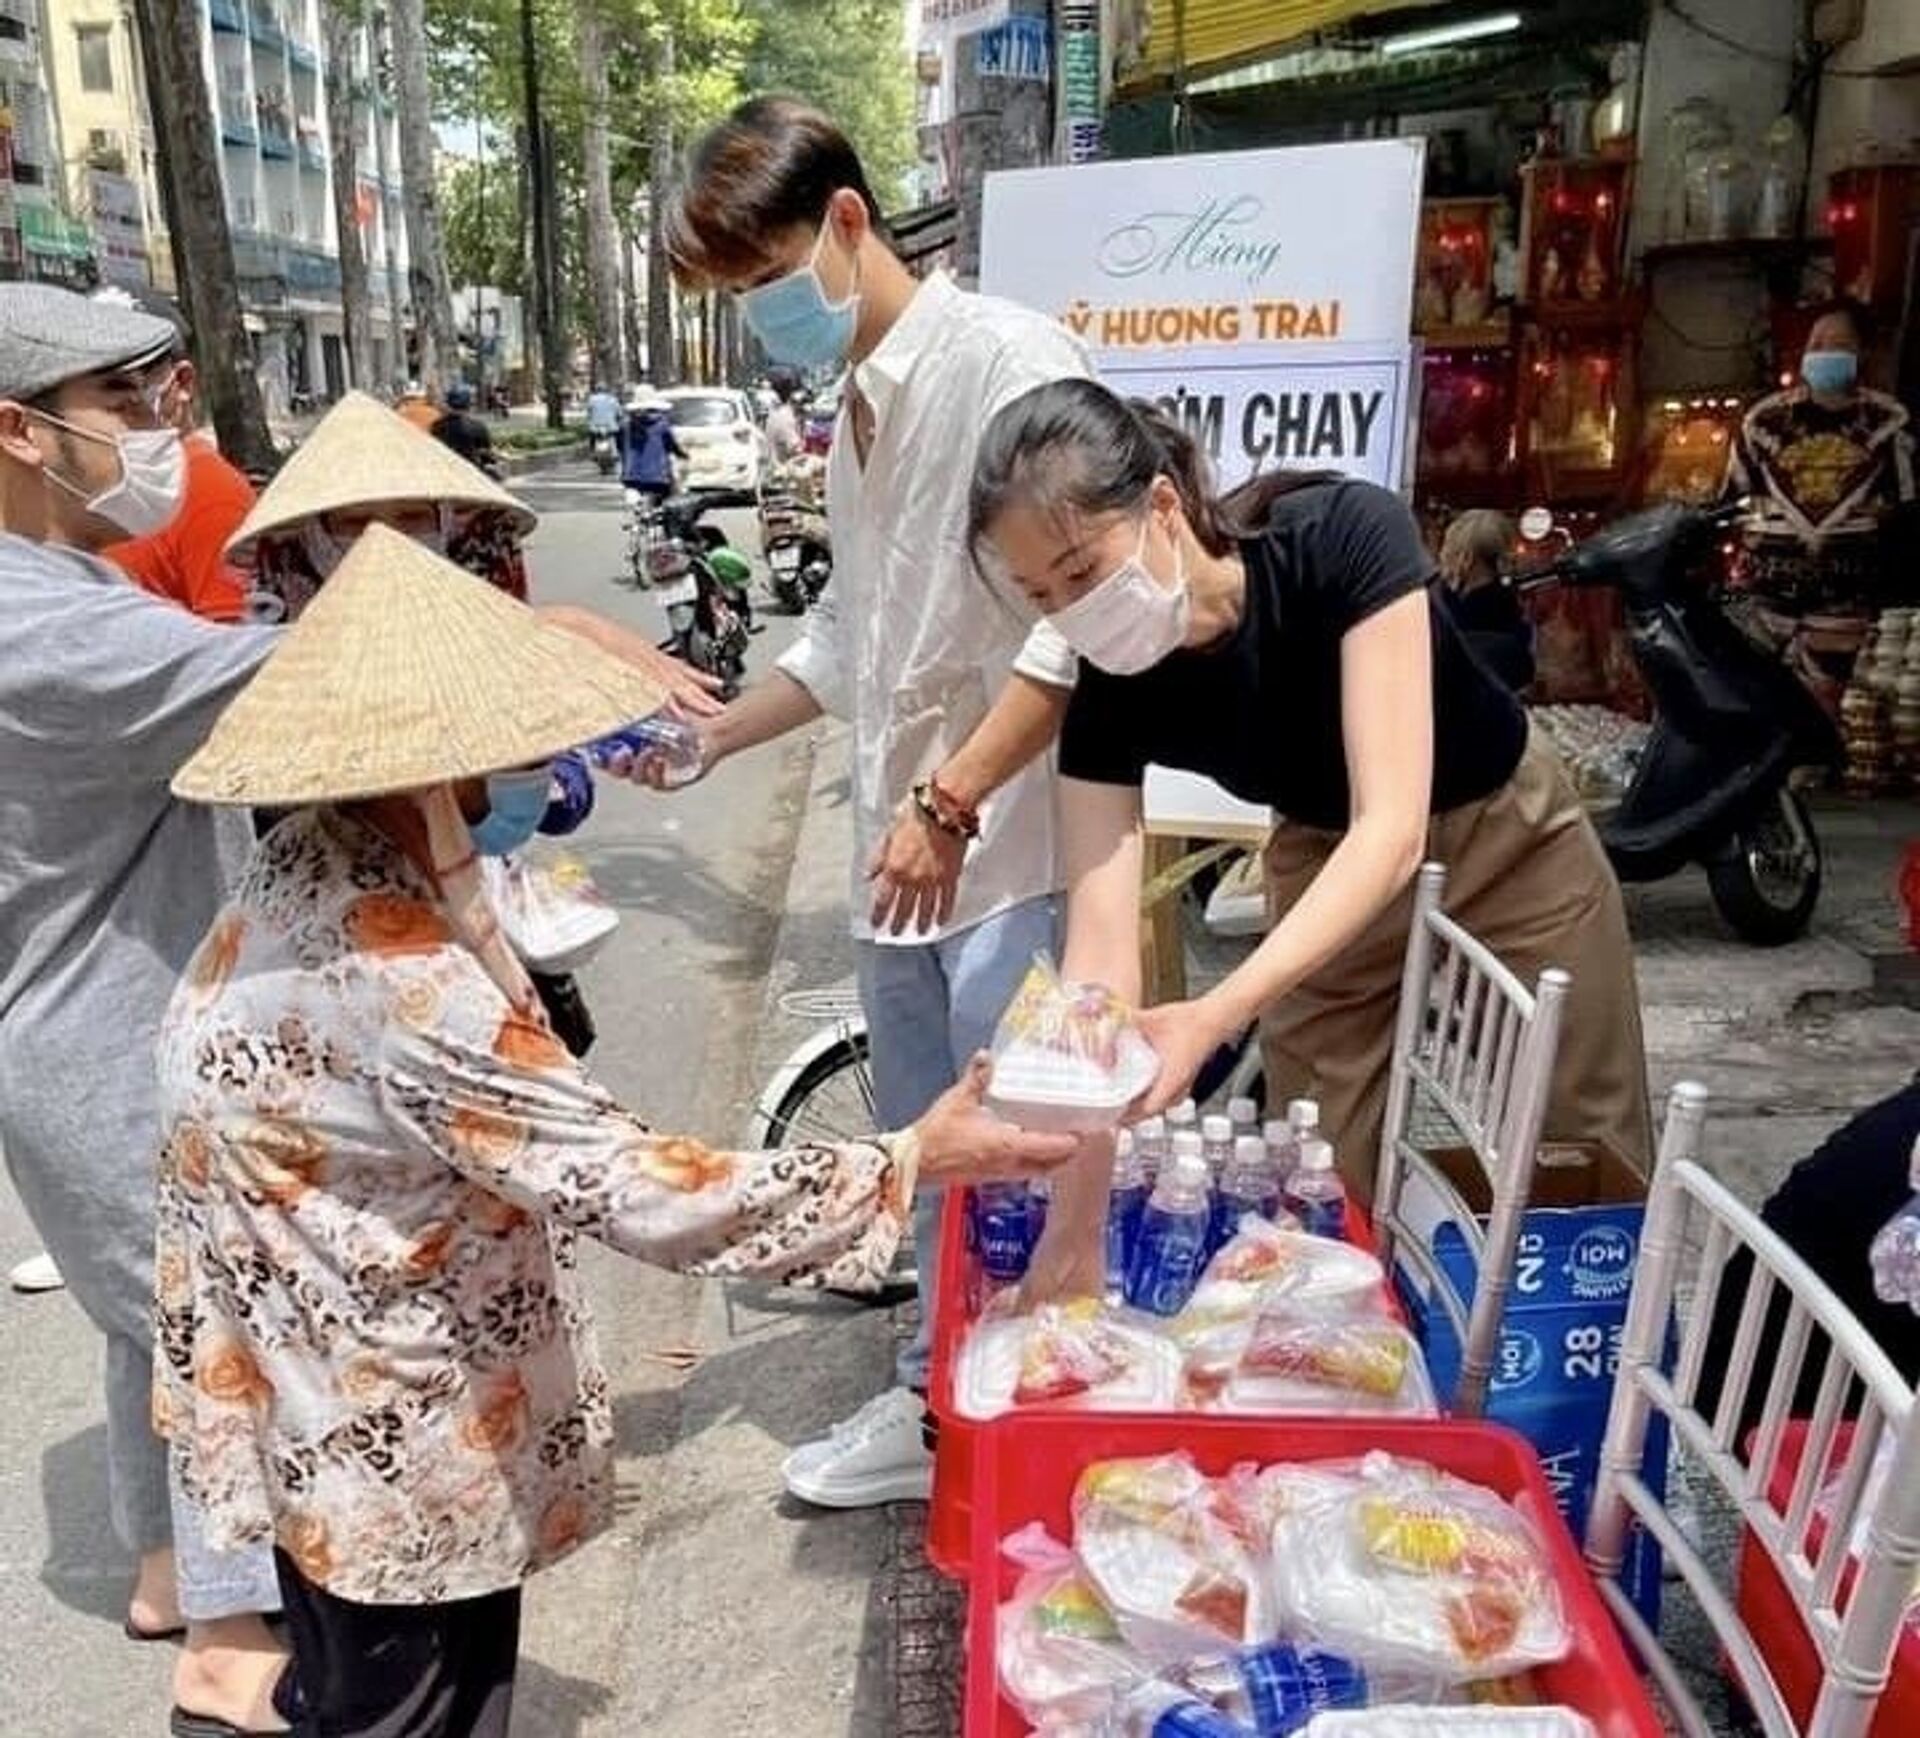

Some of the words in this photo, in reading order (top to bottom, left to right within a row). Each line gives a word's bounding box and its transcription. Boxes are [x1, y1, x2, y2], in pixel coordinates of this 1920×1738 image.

[1060, 301, 1092, 335] Ỹ
[1242, 389, 1385, 459] CHAY
[1564, 1326, 1600, 1378] 28
